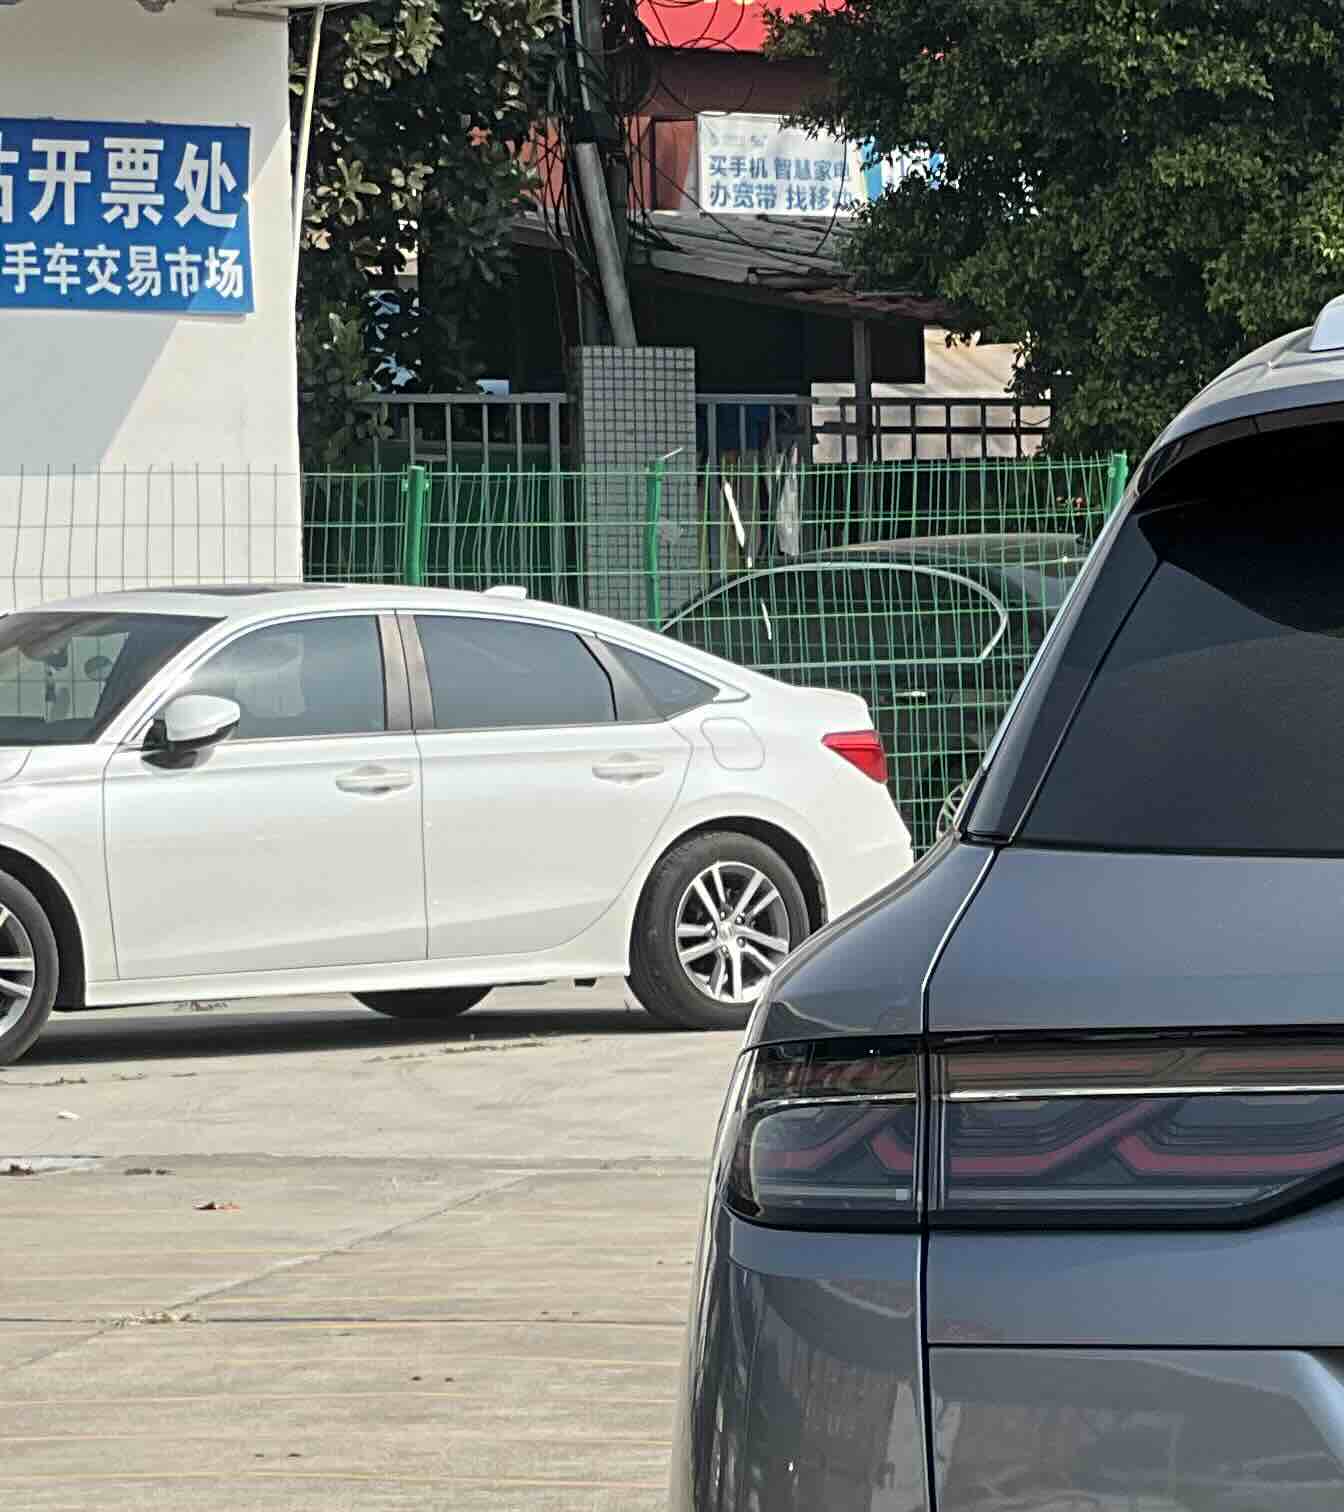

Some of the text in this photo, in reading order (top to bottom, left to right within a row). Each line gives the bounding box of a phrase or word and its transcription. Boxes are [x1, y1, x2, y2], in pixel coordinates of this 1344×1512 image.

[709, 154, 768, 178] 买手机
[2, 241, 245, 298] 手车交易市场
